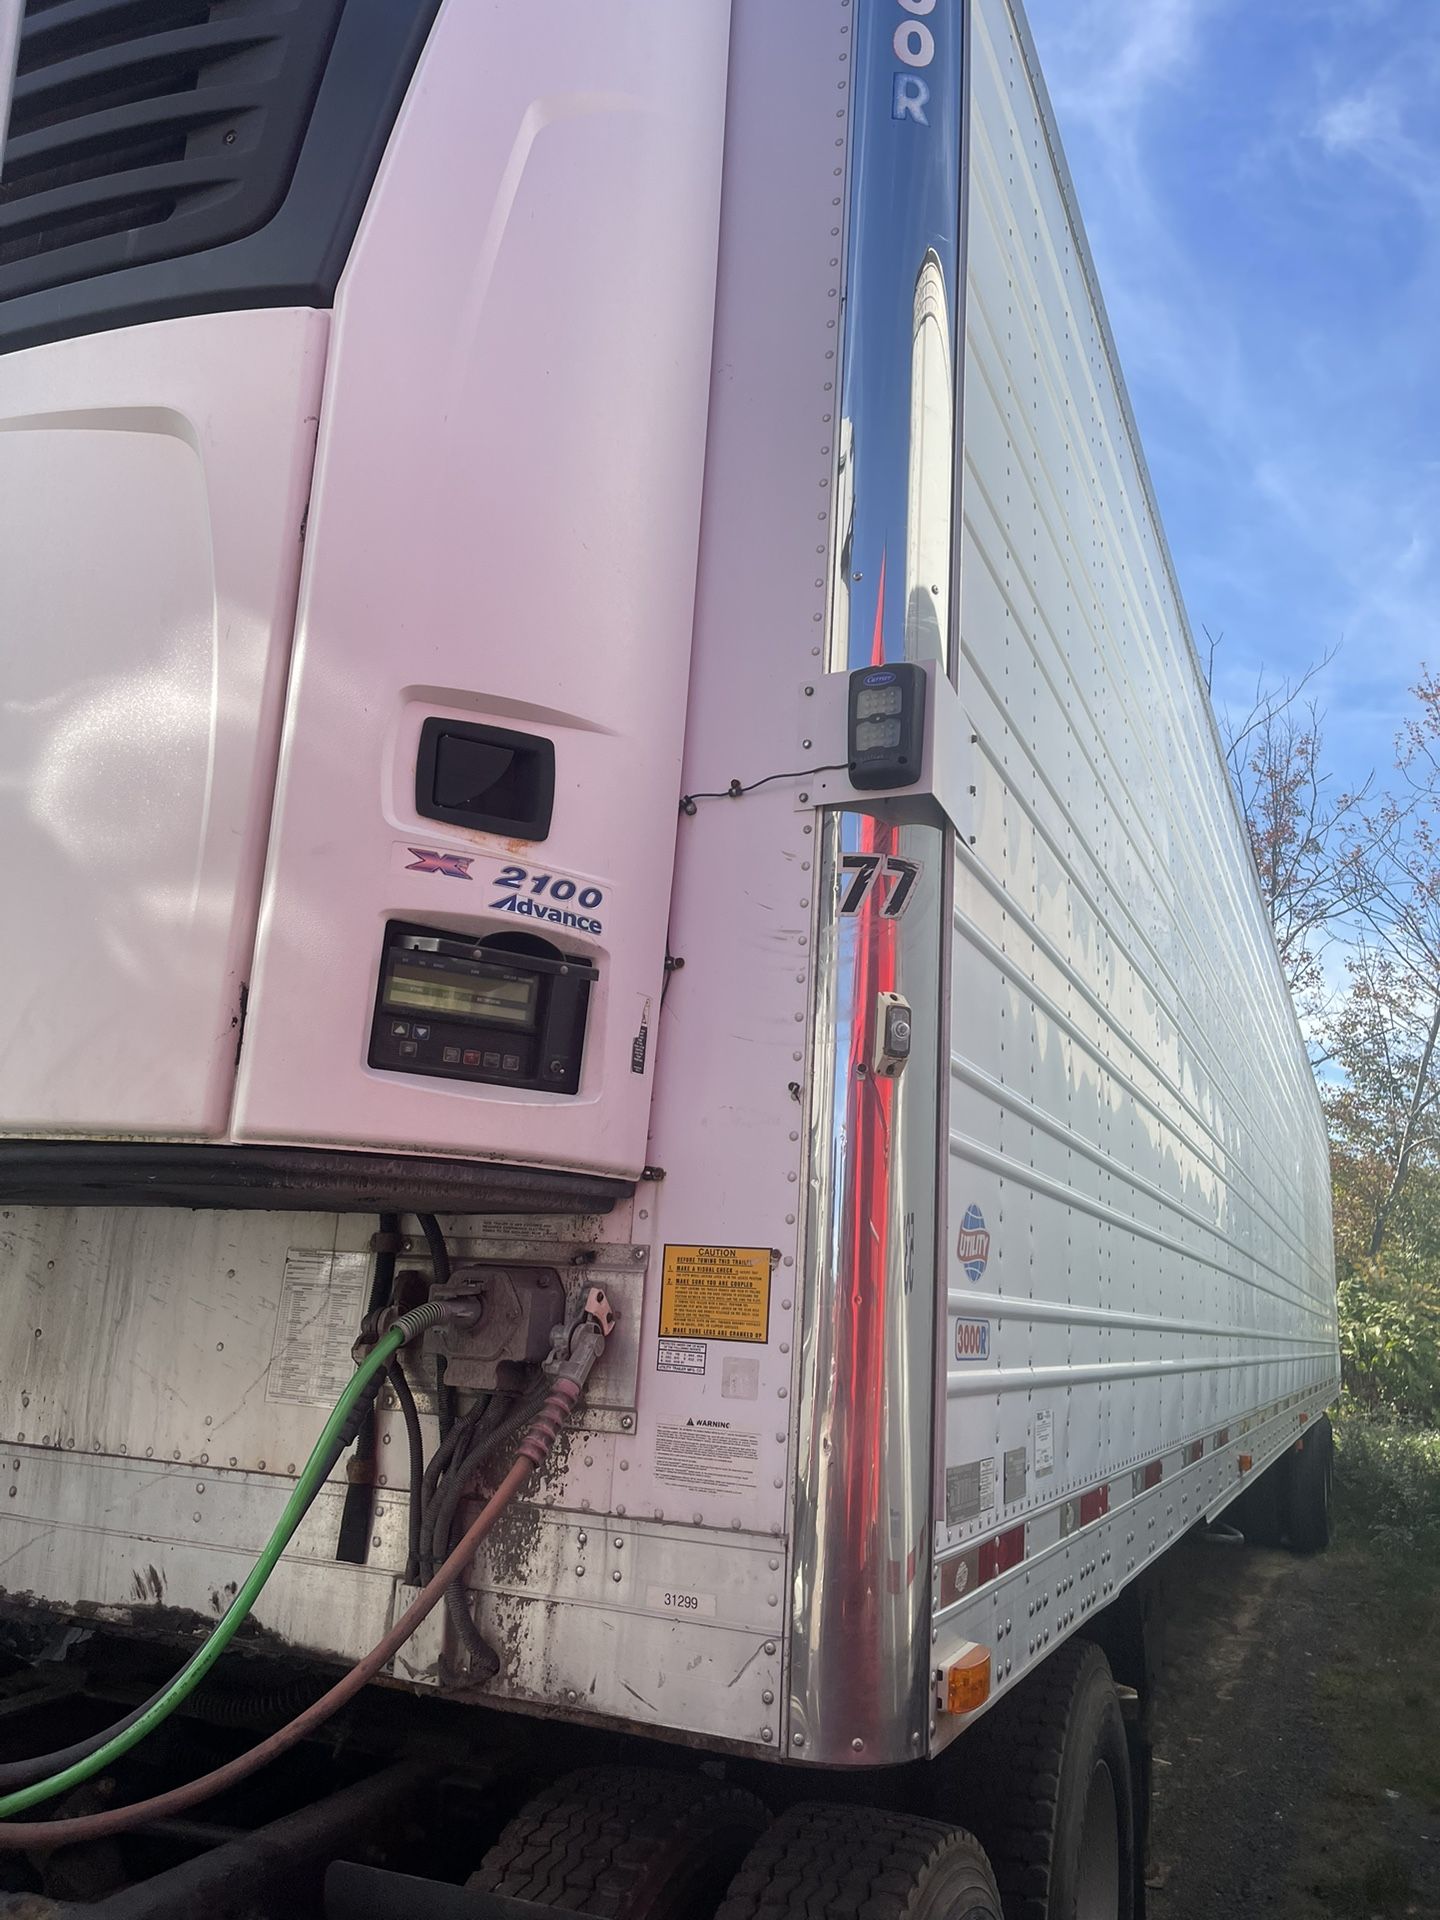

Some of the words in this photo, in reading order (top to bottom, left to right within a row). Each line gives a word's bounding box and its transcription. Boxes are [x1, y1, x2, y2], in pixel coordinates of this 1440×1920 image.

[867, 675, 892, 684] Carrier
[492, 865, 603, 909] 2100
[837, 852, 923, 921] 77
[488, 893, 602, 935] Advance
[698, 1247, 736, 1257] CAUTION
[959, 1233, 989, 1257] UTILITY
[677, 1256, 695, 1264] BEFORE
[697, 1257, 716, 1265] TOWING
[729, 1330, 753, 1338] CRANKED
[957, 1324, 987, 1355] 3000R
[696, 1419, 730, 1429] WARNING
[664, 1593, 698, 1609] 31299
